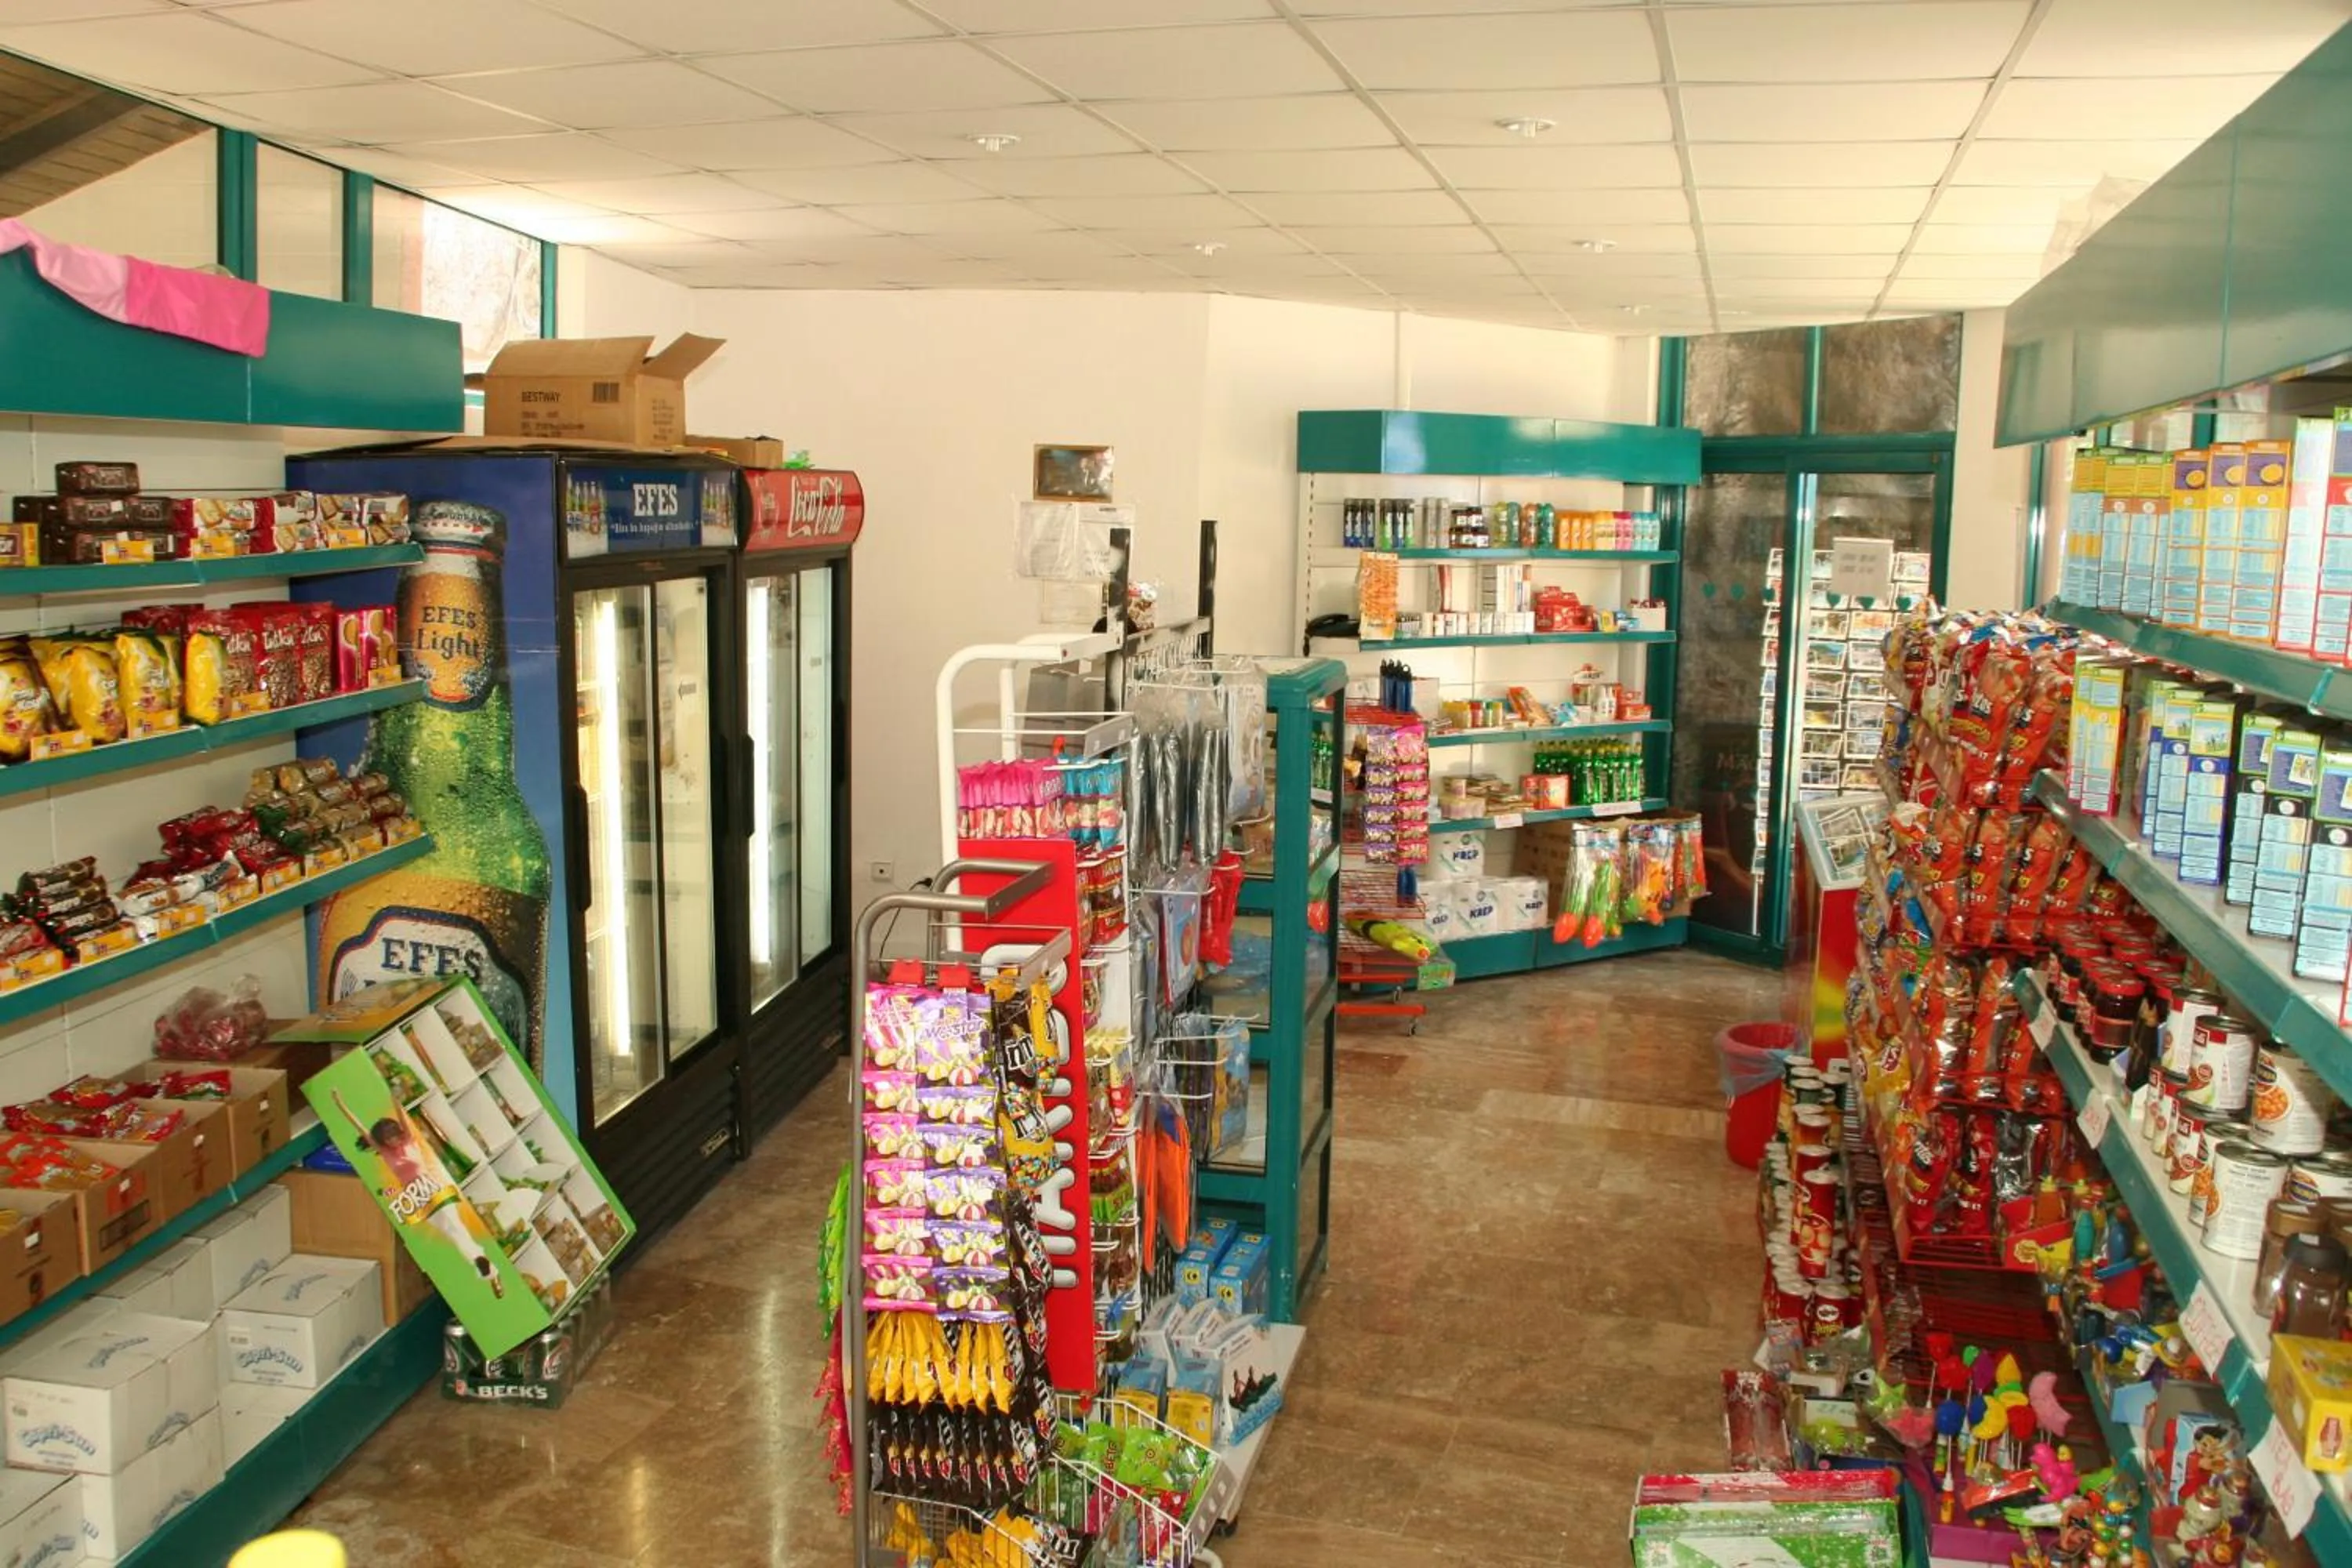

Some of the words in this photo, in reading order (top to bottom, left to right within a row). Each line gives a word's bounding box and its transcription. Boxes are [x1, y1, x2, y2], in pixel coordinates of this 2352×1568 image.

[521, 391, 561, 402] BESTWAY
[633, 483, 679, 517] EFES
[422, 605, 477, 628] EFES
[417, 628, 480, 660] Light
[1453, 849, 1479, 861] KREP
[1469, 905, 1494, 919] KREP
[381, 937, 483, 980] EFES
[388, 1174, 441, 1223] FORM
[477, 1385, 548, 1399] BECK'S
